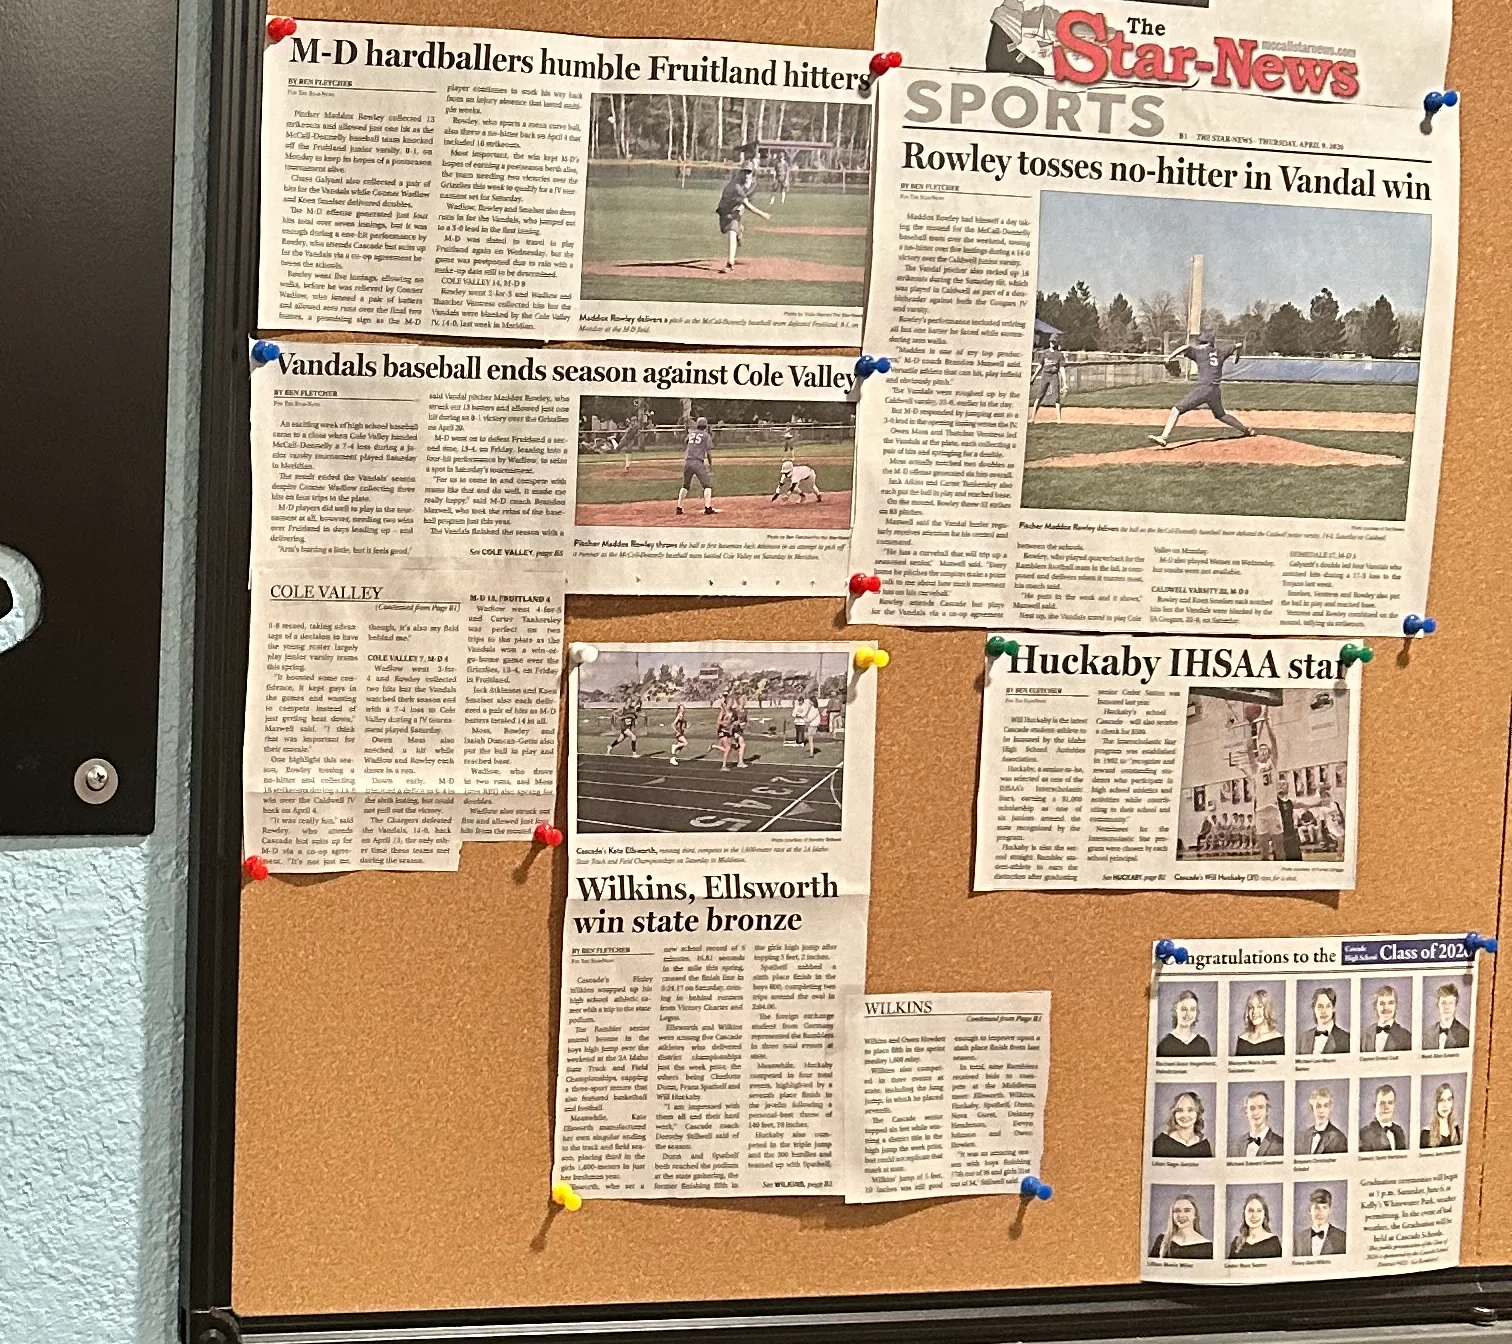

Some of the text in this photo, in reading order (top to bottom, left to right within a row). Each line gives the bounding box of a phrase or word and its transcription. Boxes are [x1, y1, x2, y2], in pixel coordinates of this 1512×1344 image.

[1126, 17, 1166, 37] The
[1051, 9, 1360, 98] Star-News
[1261, 39, 1357, 58] mccallstarnews.com
[288, 37, 872, 91] M-D hardballers humble Fruitland hitters
[903, 80, 1165, 138] SPORTS
[901, 141, 1432, 201] Rowley tosses no-hitter in Vandal win
[279, 352, 858, 395] Vandals baseball ends season against Cole Valley
[481, 548, 503, 557] COLE
[270, 585, 384, 600] COLE VALLEY
[1007, 644, 1162, 684] Huckaby
[1169, 647, 1281, 680] IHSAA
[576, 872, 839, 904] Wilkins, Ellsworth
[573, 907, 803, 934] win state bronze
[1162, 947, 1337, 970] ngratulations to the
[1379, 942, 1412, 961] Class
[1413, 941, 1436, 960] of
[865, 1000, 932, 1015] WILKINS
